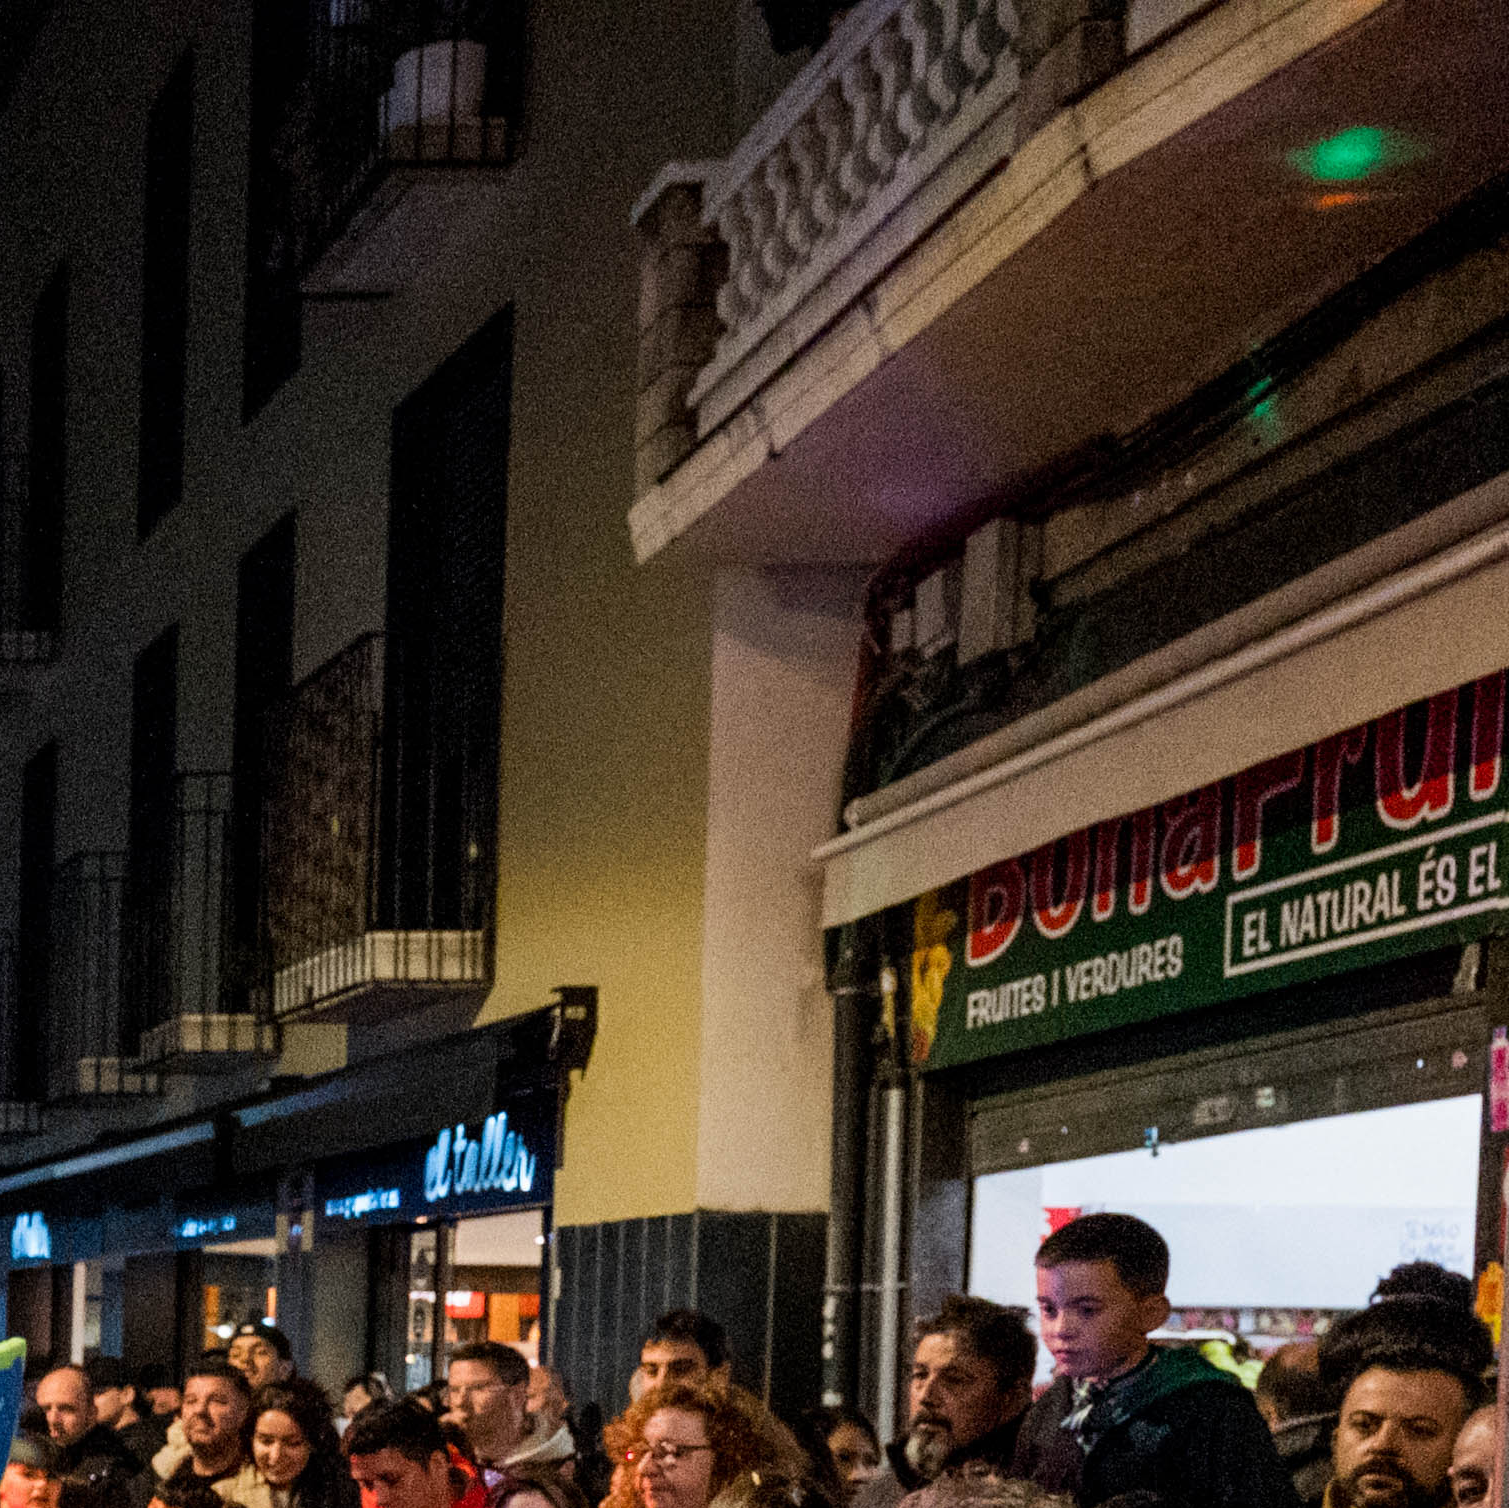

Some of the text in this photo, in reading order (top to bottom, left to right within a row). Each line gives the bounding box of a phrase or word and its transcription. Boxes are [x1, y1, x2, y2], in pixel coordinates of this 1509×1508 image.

[1242, 841, 1502, 957] EL NATURAL ÉS EL
[967, 934, 1183, 1029] FRUITES I VERDURES
